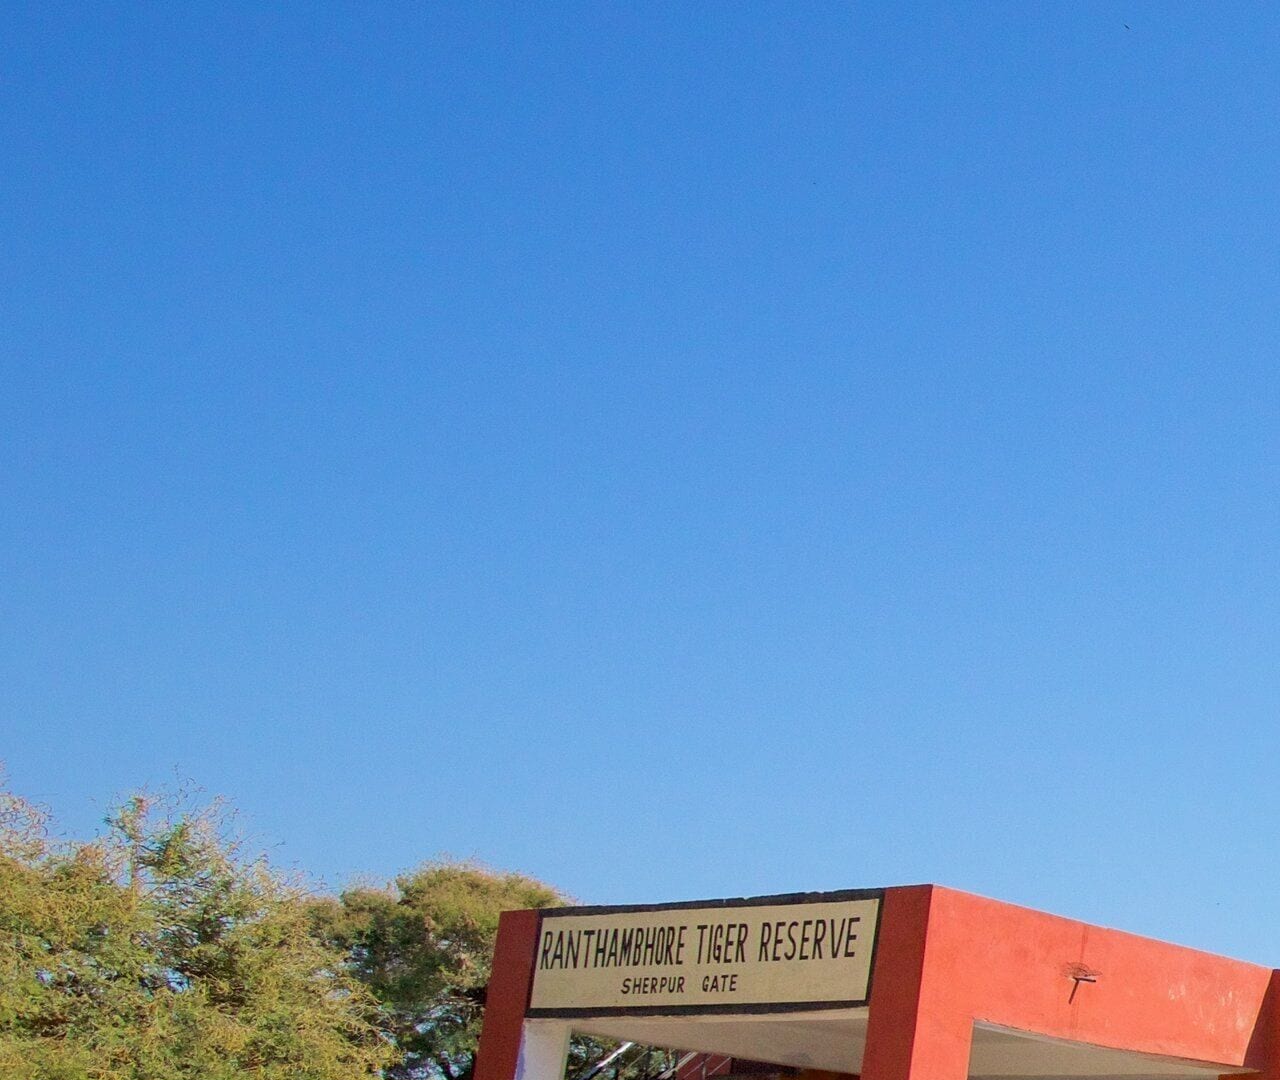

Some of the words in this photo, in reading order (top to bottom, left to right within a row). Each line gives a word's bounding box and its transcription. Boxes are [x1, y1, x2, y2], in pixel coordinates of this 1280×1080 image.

[540, 925, 688, 970] RANTHAMBHORE
[697, 923, 749, 965] TIGER
[758, 917, 861, 961] RESERVE
[620, 975, 685, 995] SHERPUR
[702, 974, 739, 993] GATE
